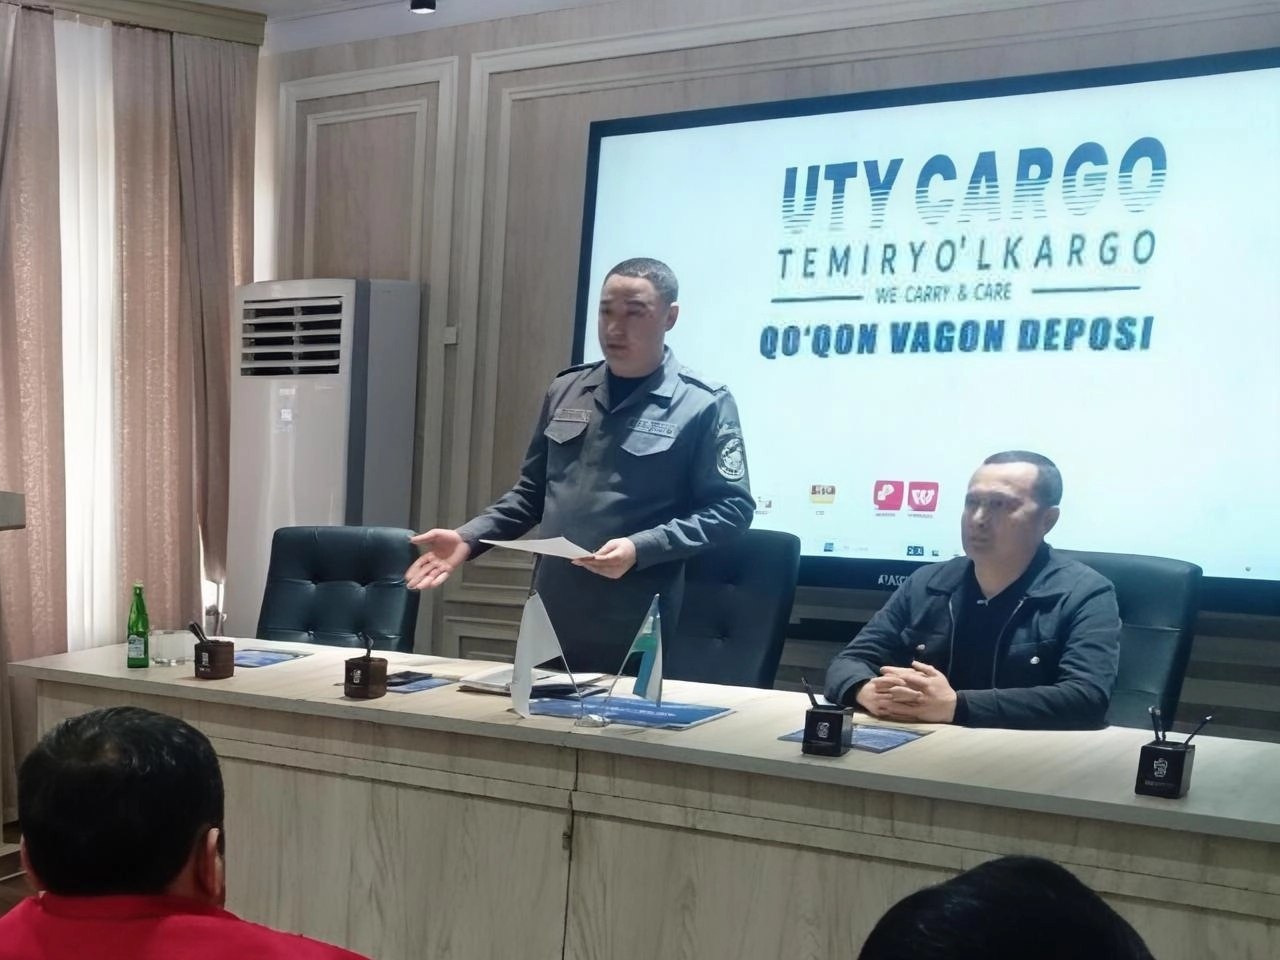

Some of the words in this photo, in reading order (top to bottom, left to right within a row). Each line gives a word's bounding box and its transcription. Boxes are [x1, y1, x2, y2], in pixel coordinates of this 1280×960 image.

[781, 157, 905, 232] UTY
[914, 136, 1168, 224] CARGO
[778, 229, 1157, 280] TEMIRYO'LKARGO
[875, 286, 897, 304] WE
[905, 285, 951, 304] CARRY
[957, 284, 968, 302] &
[974, 282, 1012, 301] CARE
[759, 322, 879, 360] QO'QON
[889, 318, 1006, 354] VAGON
[1017, 315, 1155, 353] DEPOSI
